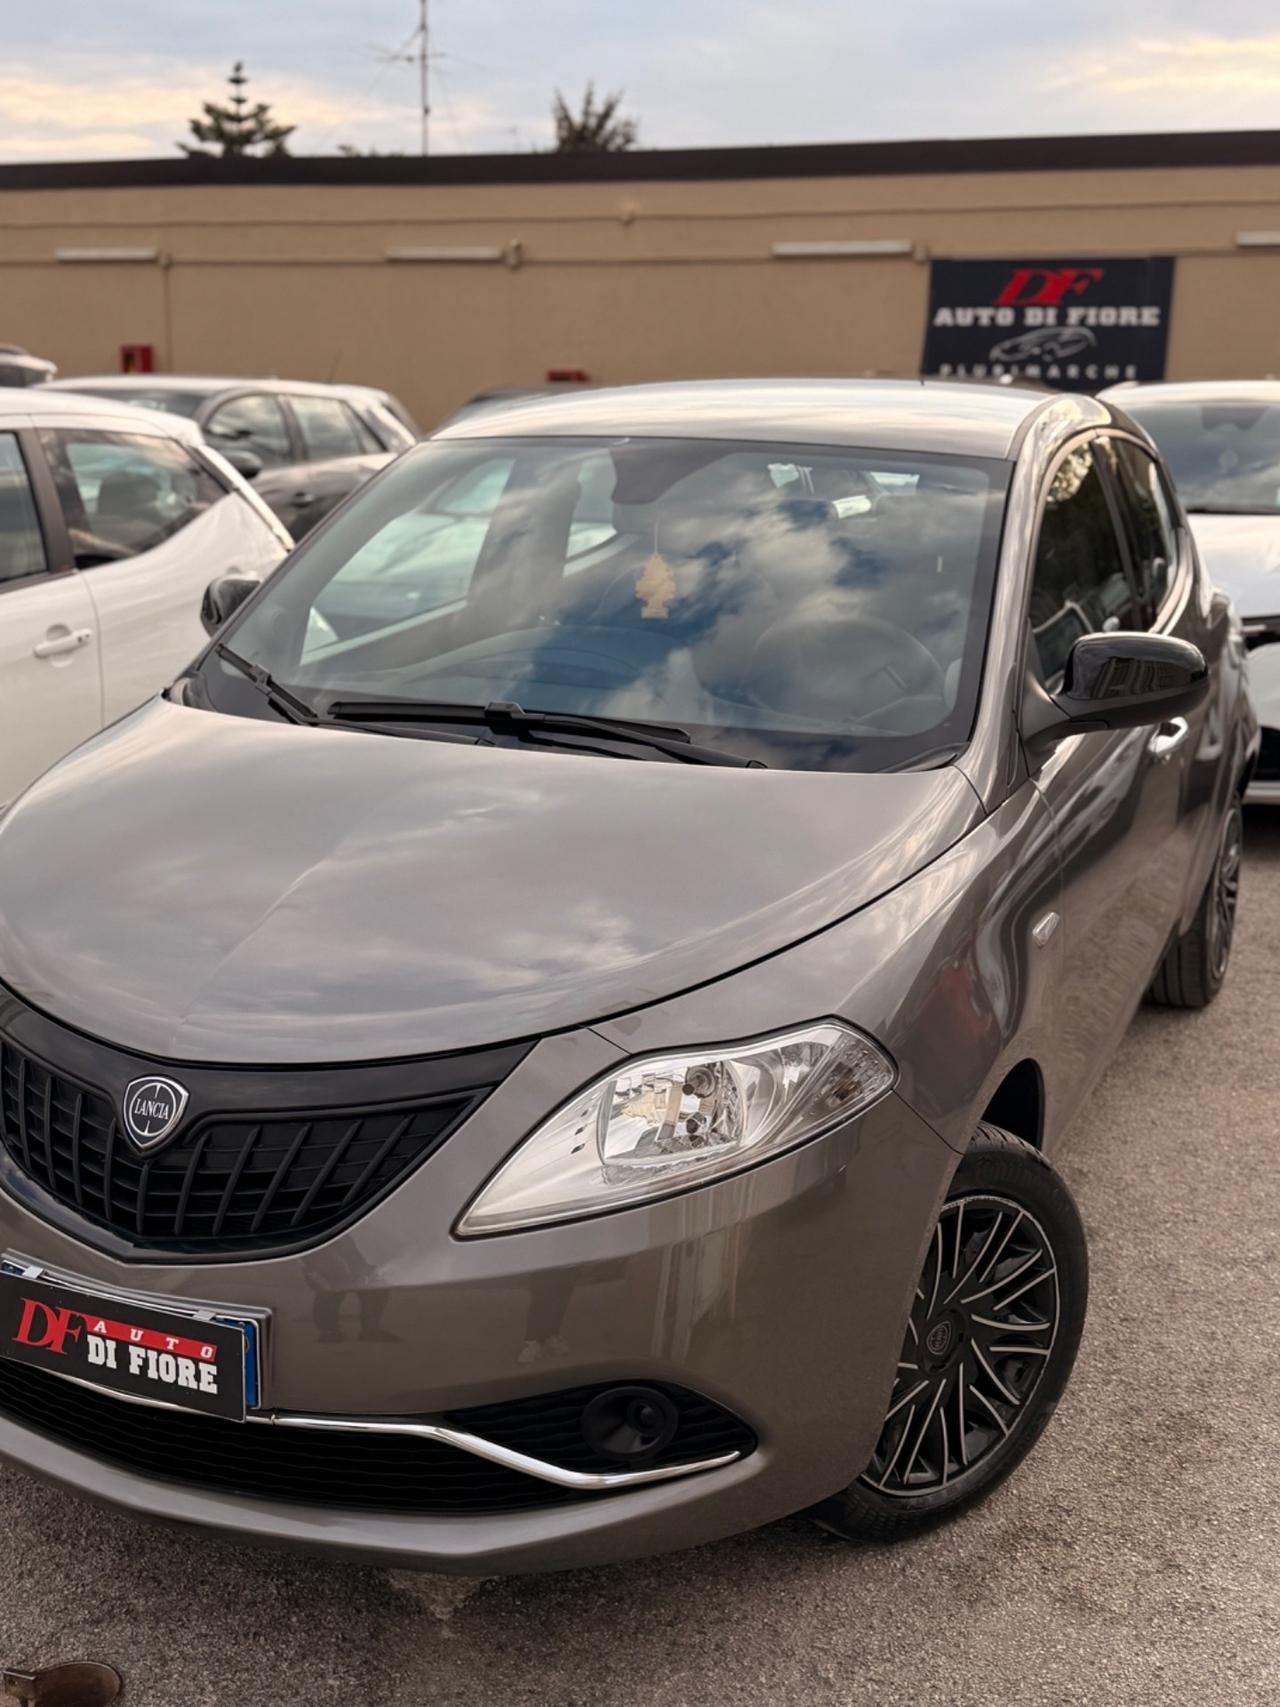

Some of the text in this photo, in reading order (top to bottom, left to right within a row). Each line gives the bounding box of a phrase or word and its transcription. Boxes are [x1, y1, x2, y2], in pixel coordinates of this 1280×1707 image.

[994, 268, 1104, 306] DF
[934, 307, 1161, 326] AUTO DI FIORE
[134, 1098, 170, 1120] LANCIA
[12, 1298, 87, 1354] DF
[94, 1321, 214, 1359] AUTO
[87, 1334, 218, 1394] DI FIORE
